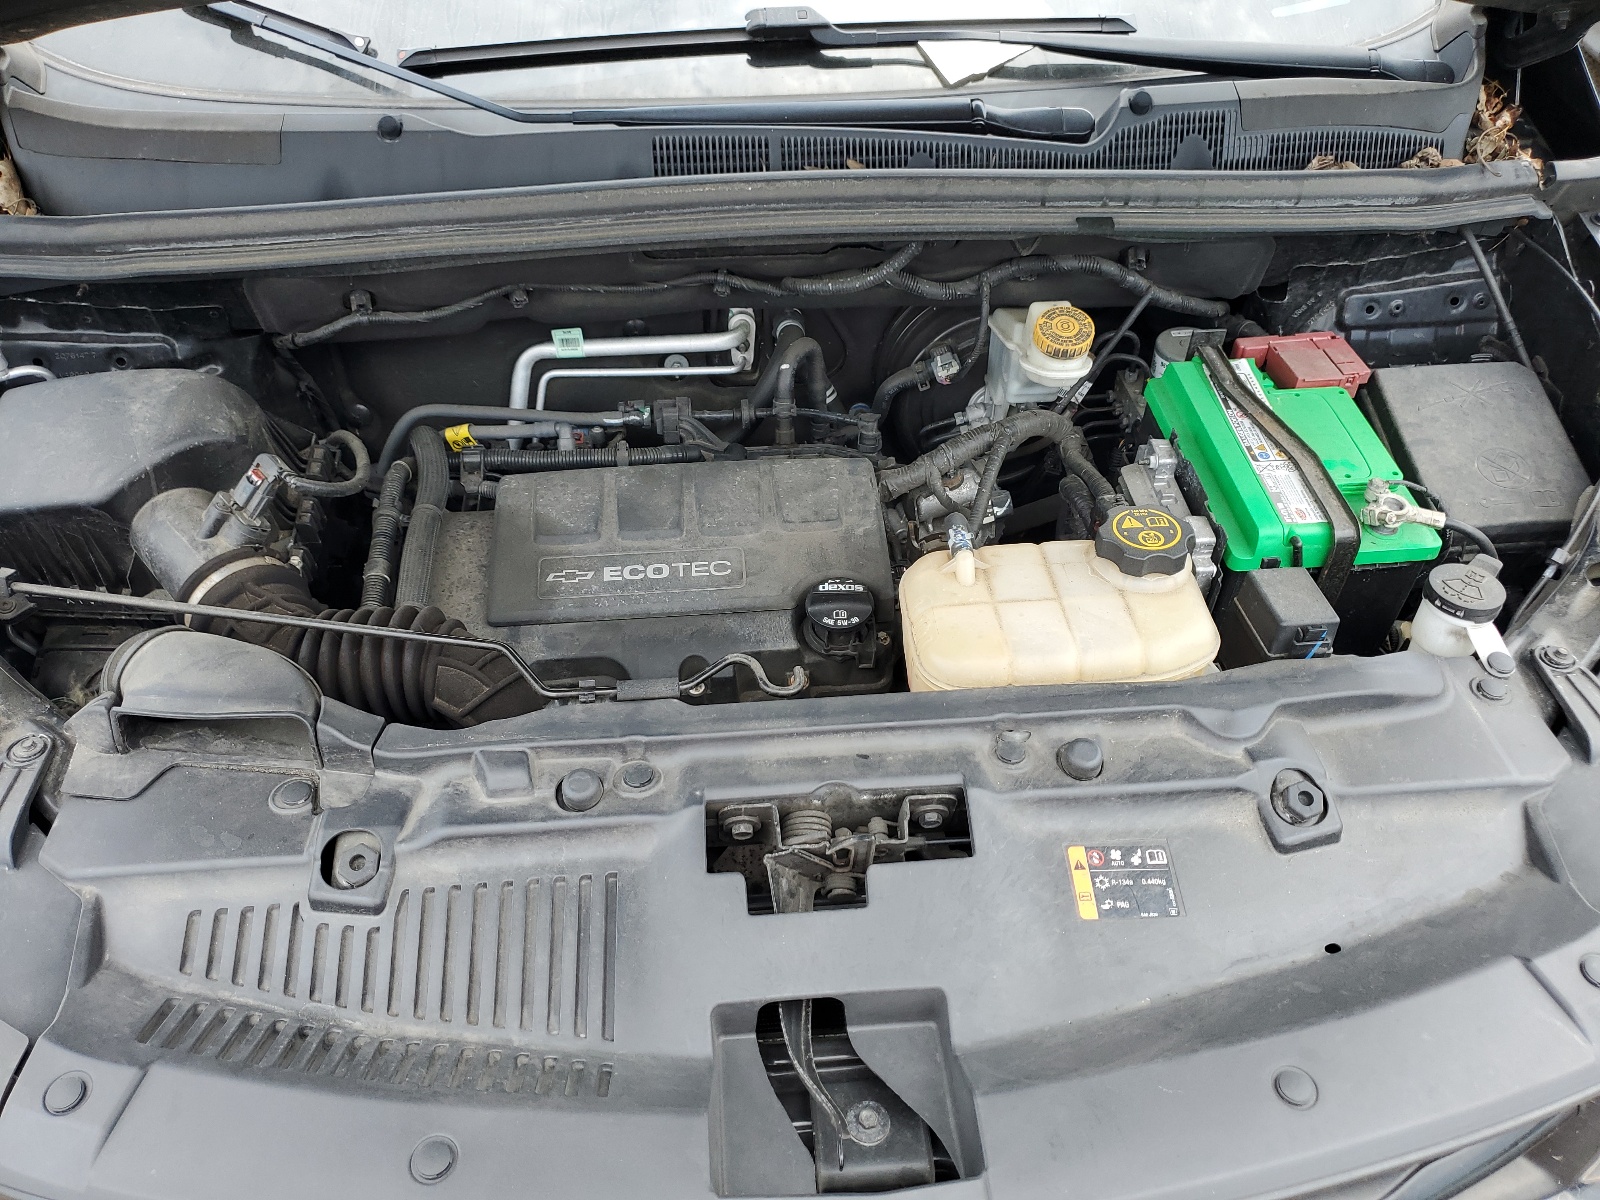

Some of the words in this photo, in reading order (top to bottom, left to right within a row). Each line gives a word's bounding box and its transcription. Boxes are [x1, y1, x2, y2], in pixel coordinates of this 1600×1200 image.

[603, 560, 732, 582] ECOTEC
[818, 582, 865, 592] dexos
[822, 616, 836, 626] SAE
[837, 616, 860, 626] 5W-30
[1116, 900, 1130, 909] PAG
